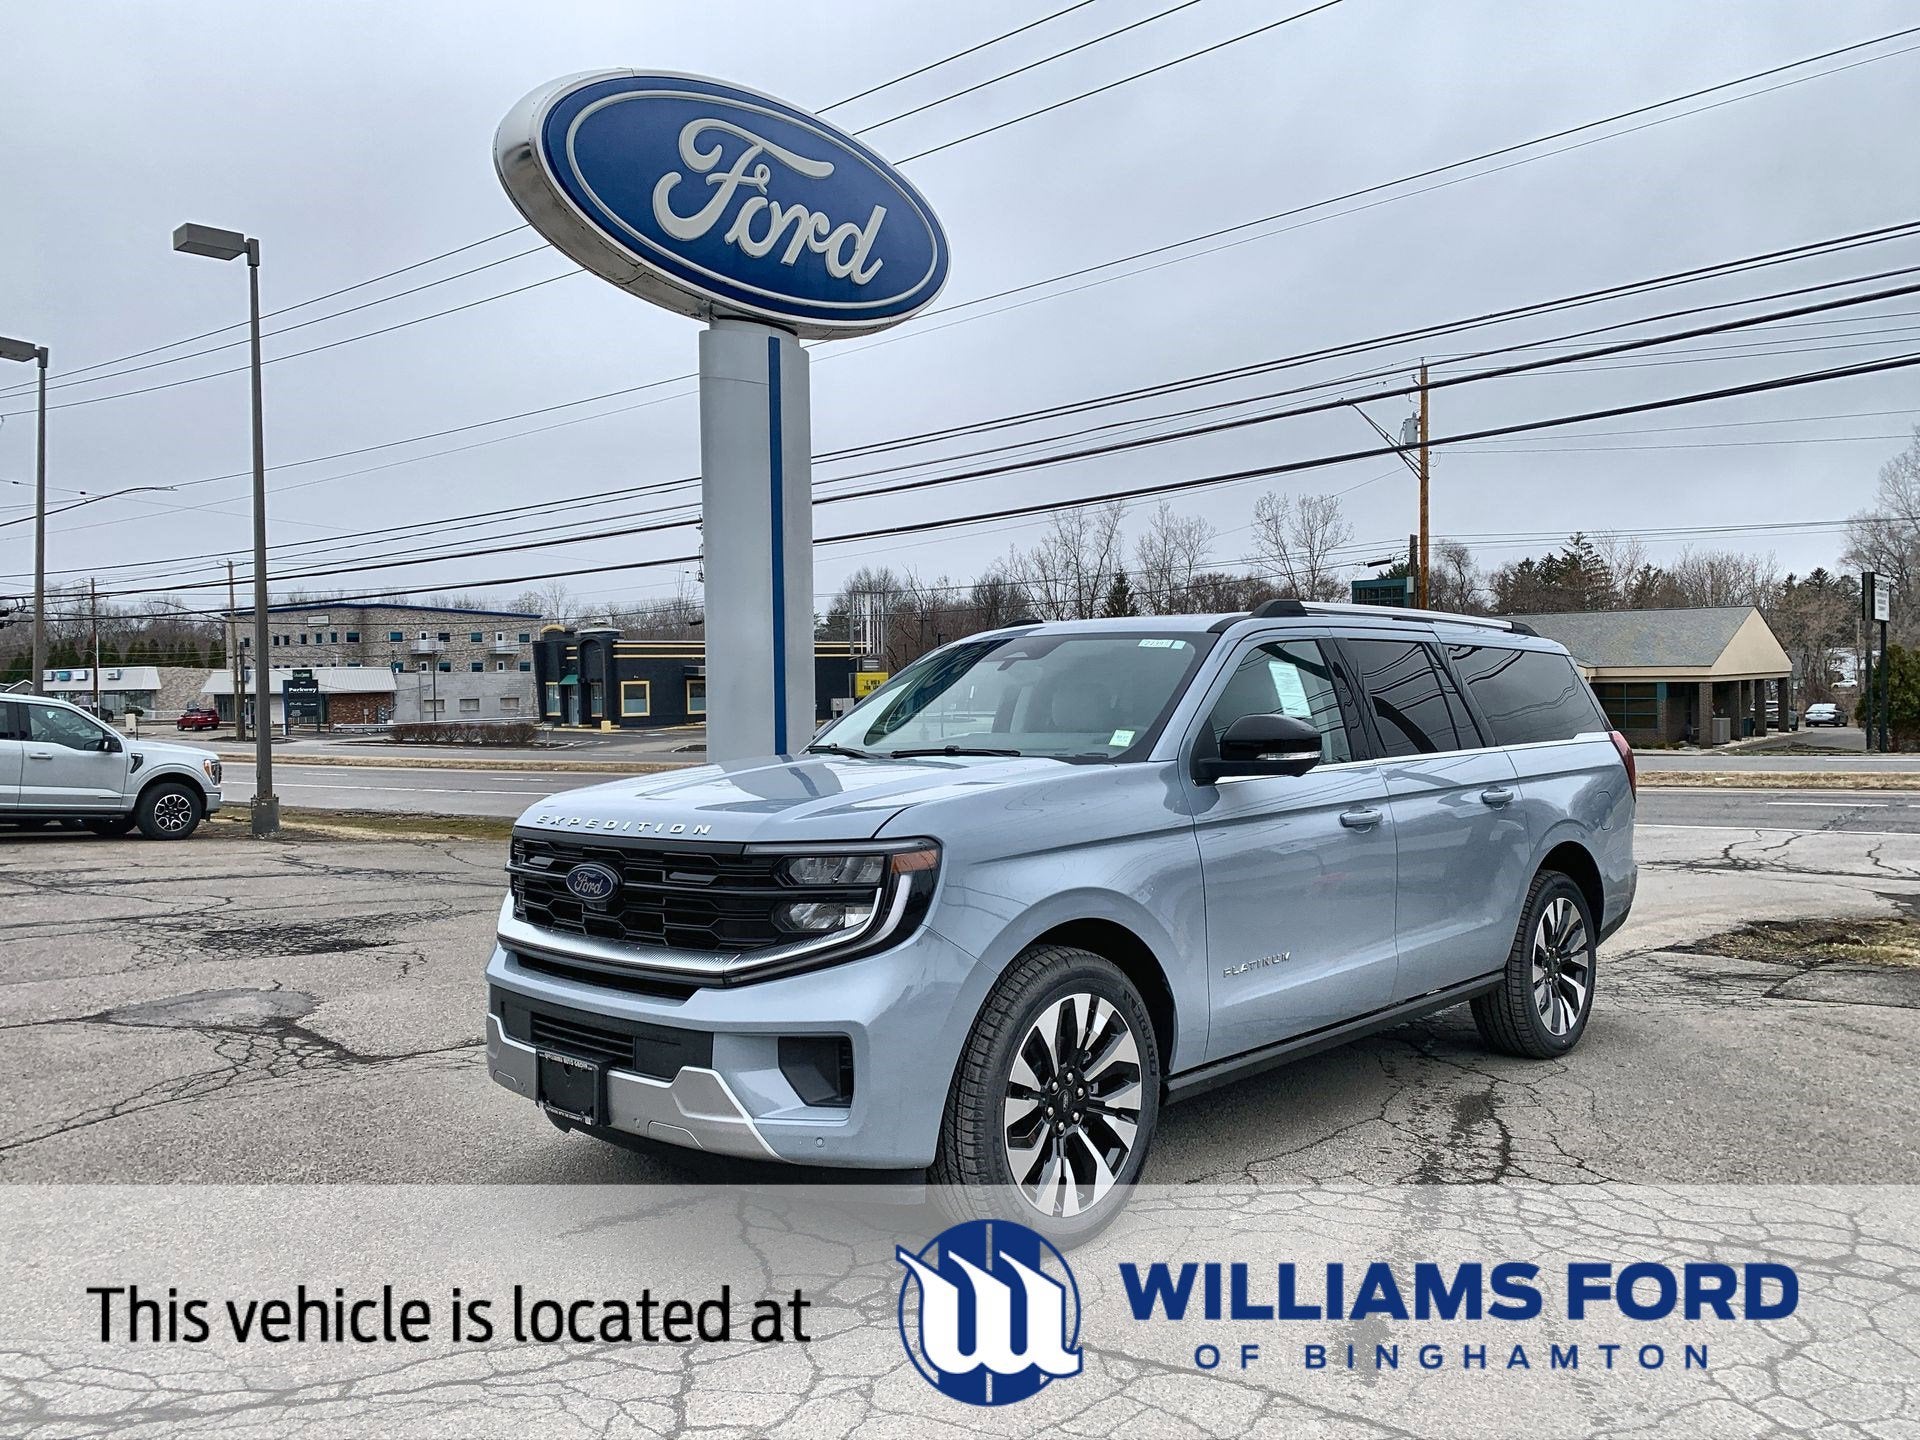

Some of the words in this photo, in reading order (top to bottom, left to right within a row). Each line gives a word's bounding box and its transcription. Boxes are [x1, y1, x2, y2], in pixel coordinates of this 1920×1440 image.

[652, 117, 889, 287] Ford
[535, 814, 713, 836] EXPEDITION
[573, 870, 604, 895] Ford
[1222, 950, 1291, 979] PLATINUM
